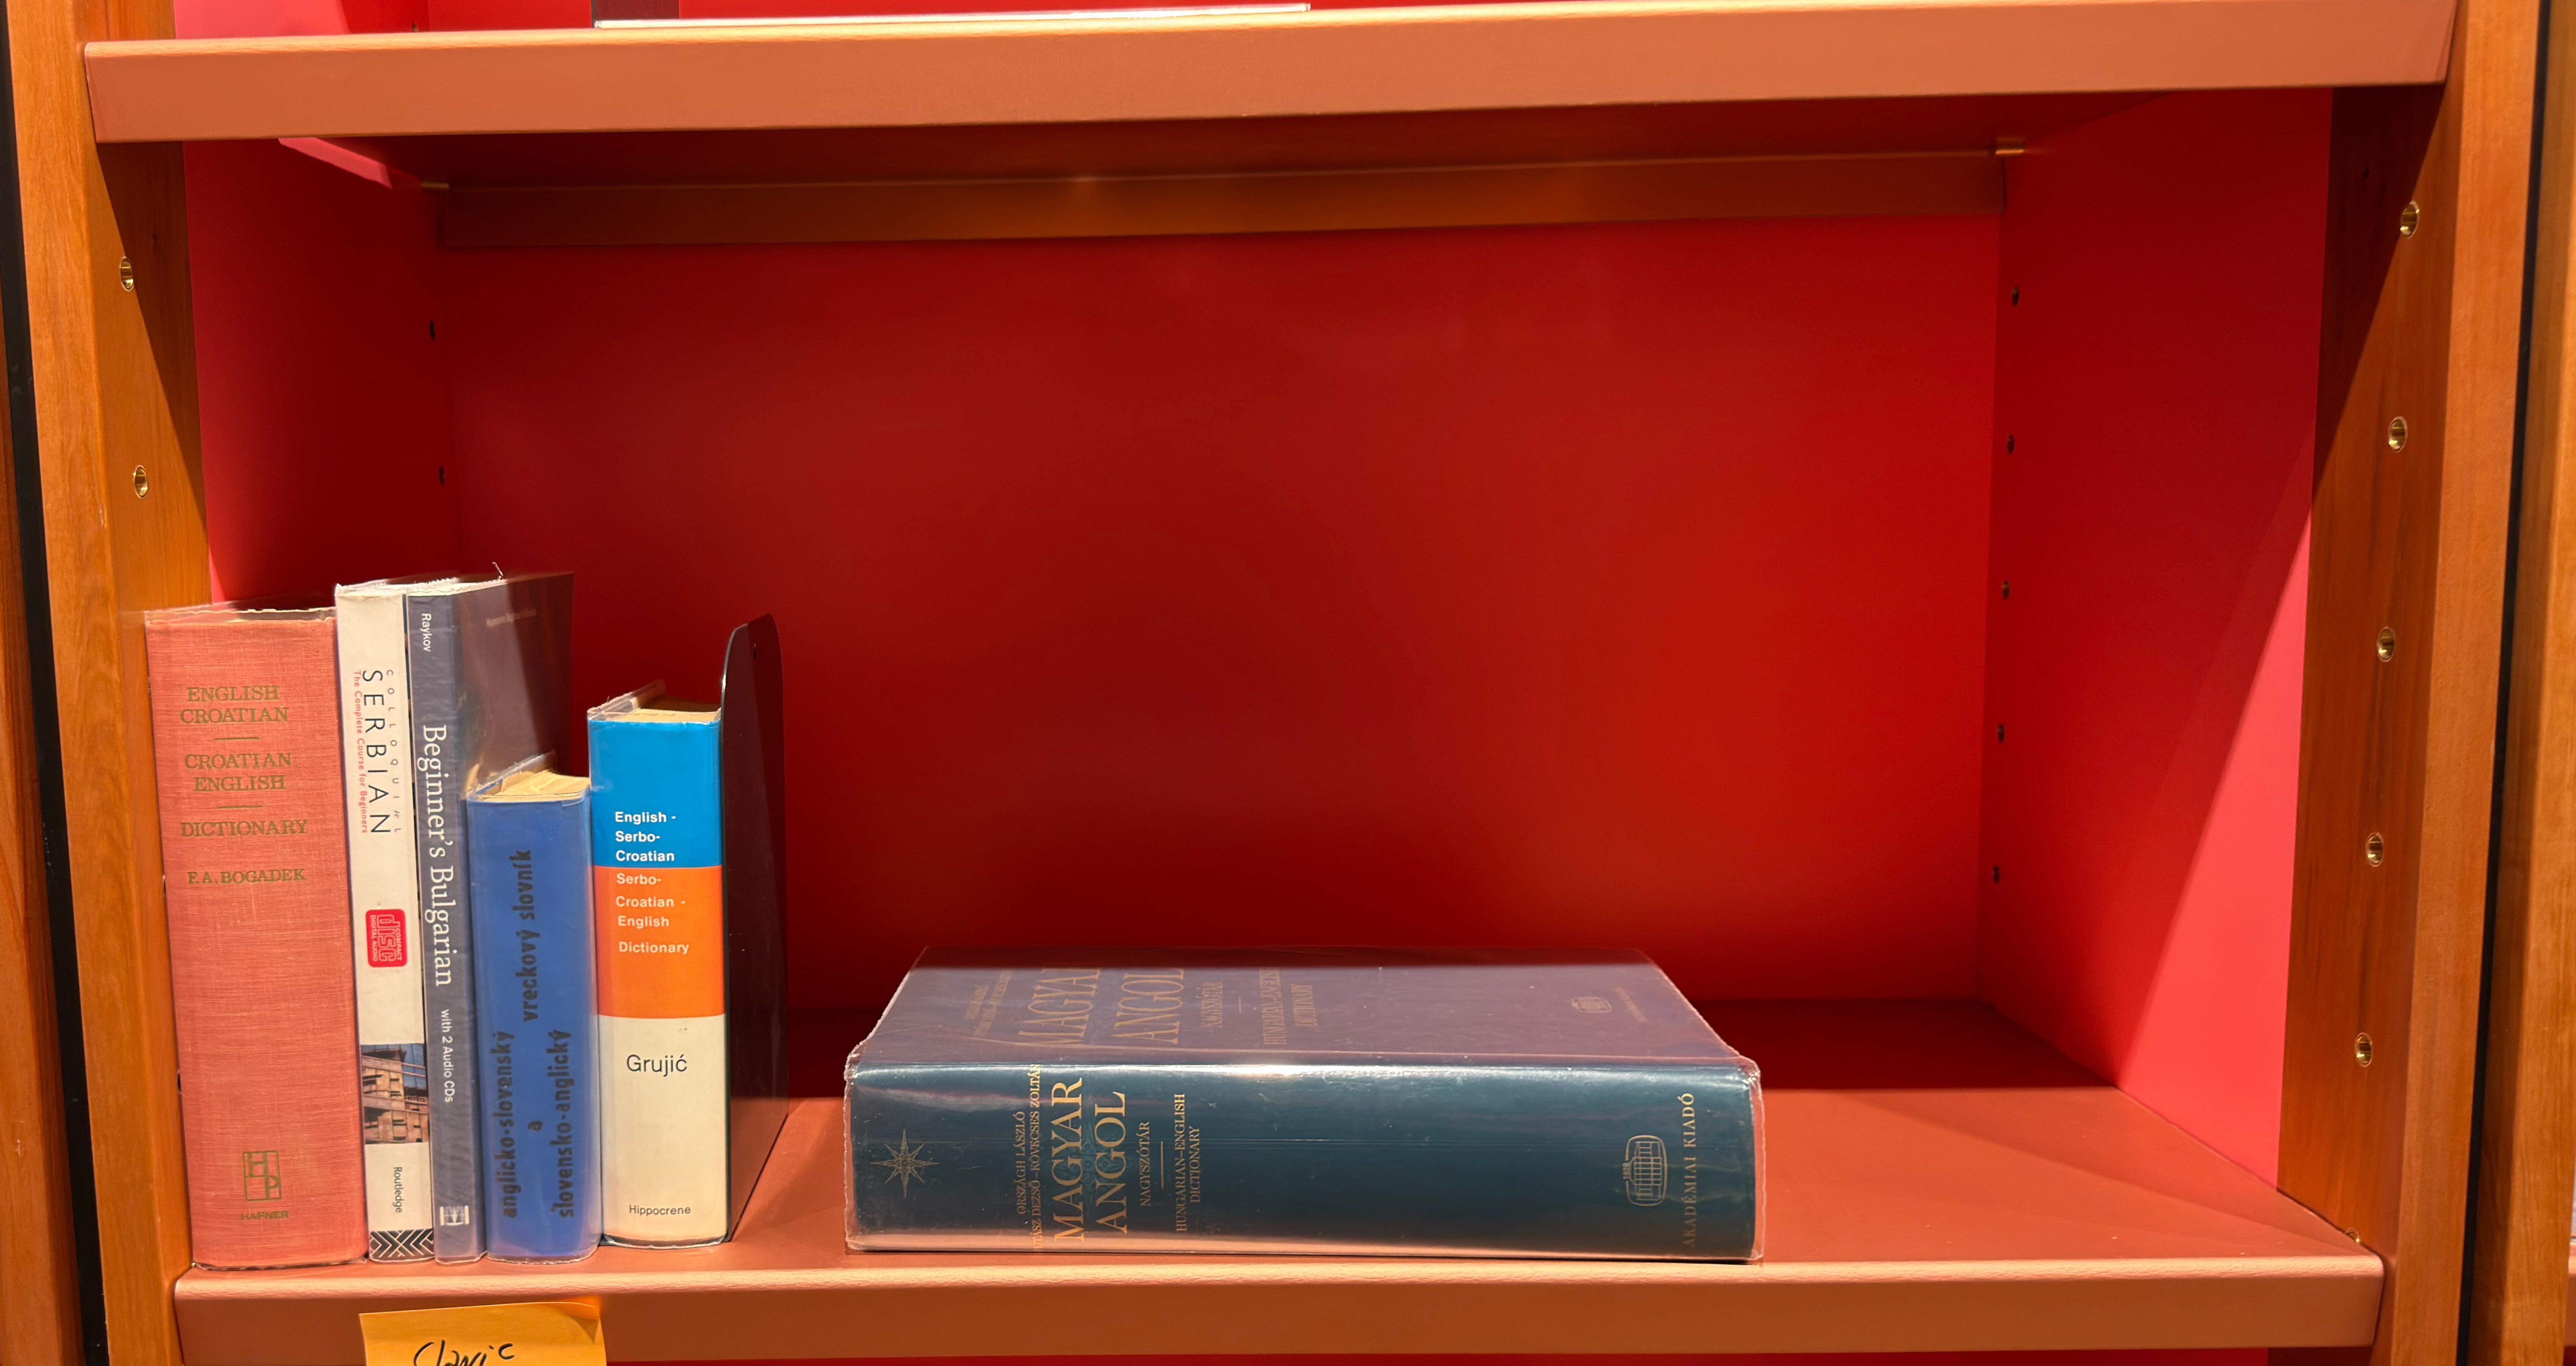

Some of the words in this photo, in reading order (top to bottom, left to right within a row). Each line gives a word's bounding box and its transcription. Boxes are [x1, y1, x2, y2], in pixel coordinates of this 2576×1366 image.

[421, 613, 433, 652] Raykov
[186, 685, 280, 702] ENGLISH
[180, 707, 289, 724] CROATIAN
[354, 691, 363, 734] Complete
[185, 753, 292, 770] CROATIAN
[357, 738, 365, 770] Course
[362, 670, 391, 833] SERBIAN
[194, 775, 286, 792] ENGLISH
[359, 773, 367, 787] for
[416, 725, 454, 859] Beginner's
[181, 819, 308, 837] DICTIONARY
[358, 791, 368, 833] Beginners
[615, 811, 667, 825] English
[615, 830, 661, 842] Serbo-
[615, 850, 675, 862] Croatian
[616, 873, 661, 885] Serbo-
[615, 896, 675, 907] Croatian
[376, 914, 400, 961] disc
[424, 865, 458, 987] Bulgarian
[618, 916, 670, 929] English
[618, 941, 690, 955] Dictionary
[515, 929, 540, 1023] vreckový
[441, 1008, 451, 1033] with
[1112, 967, 1185, 1045] ANGOL
[442, 1035, 453, 1045] 2
[443, 1045, 454, 1078] Audio
[626, 1054, 688, 1078] Grujić
[444, 1080, 456, 1103] CDs
[1027, 1064, 1041, 1108] ZOLTÁN
[490, 1030, 521, 1219] anglicko-slovenský
[527, 1120, 543, 1132] a
[546, 1029, 575, 1219] slovensko-anglický
[1013, 1111, 1026, 1156] LÁSZLÓ
[1677, 1093, 1697, 1148] KIADÓ
[1050, 1077, 1086, 1242] MAGYAR
[1094, 1091, 1128, 1235] ANGOL
[1136, 1121, 1151, 1207] NAGYSZÓTÁR
[1189, 1126, 1201, 1203] DICTIONARY
[393, 1166, 404, 1213] Routledge
[1680, 1157, 1697, 1247] AKADÉMIAI
[240, 1210, 290, 1220] HAFNER
[629, 1204, 691, 1216] Hippocrene
